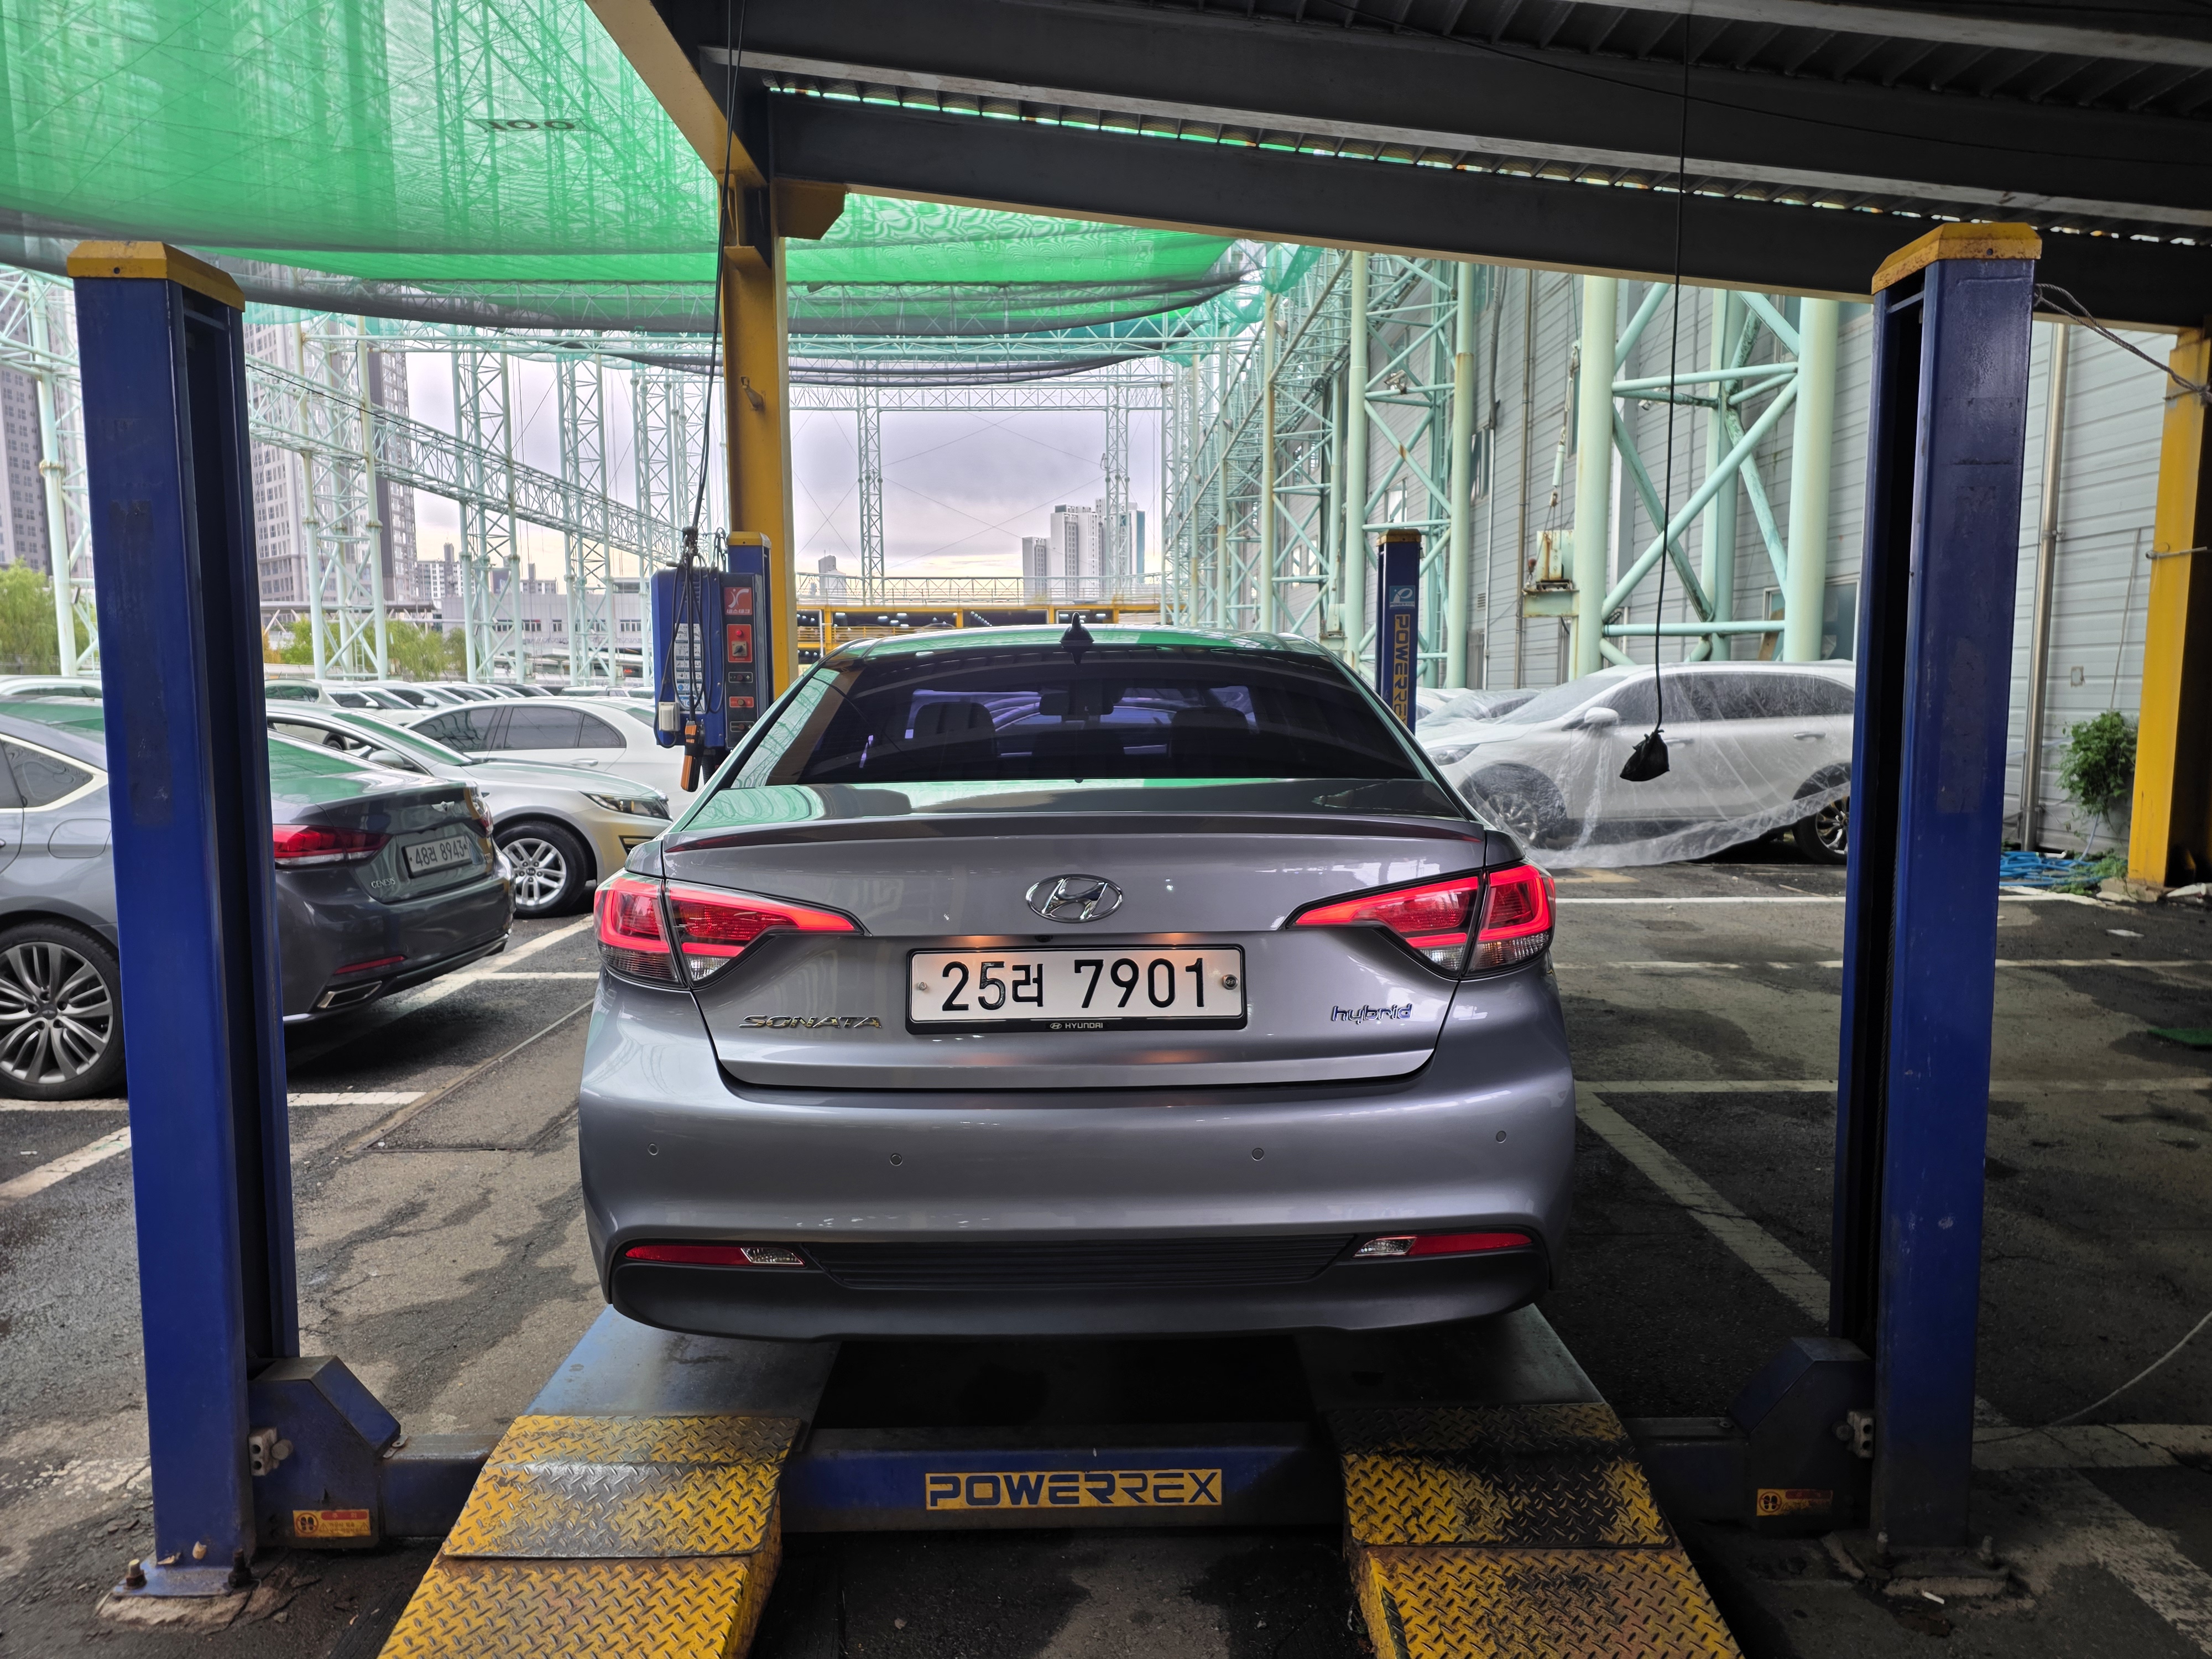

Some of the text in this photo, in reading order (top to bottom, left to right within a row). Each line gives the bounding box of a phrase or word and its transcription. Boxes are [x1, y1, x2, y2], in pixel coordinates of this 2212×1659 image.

[487, 120, 575, 130] 100
[1394, 615, 1409, 724] POWERRE
[440, 839, 465, 861] 8943
[371, 877, 395, 889] GENESIS
[942, 957, 1205, 1011] 25러 7901
[738, 1015, 882, 1029] SONATA
[1331, 1003, 1412, 1025] hybrid
[930, 1472, 1218, 1506] POWERREX
